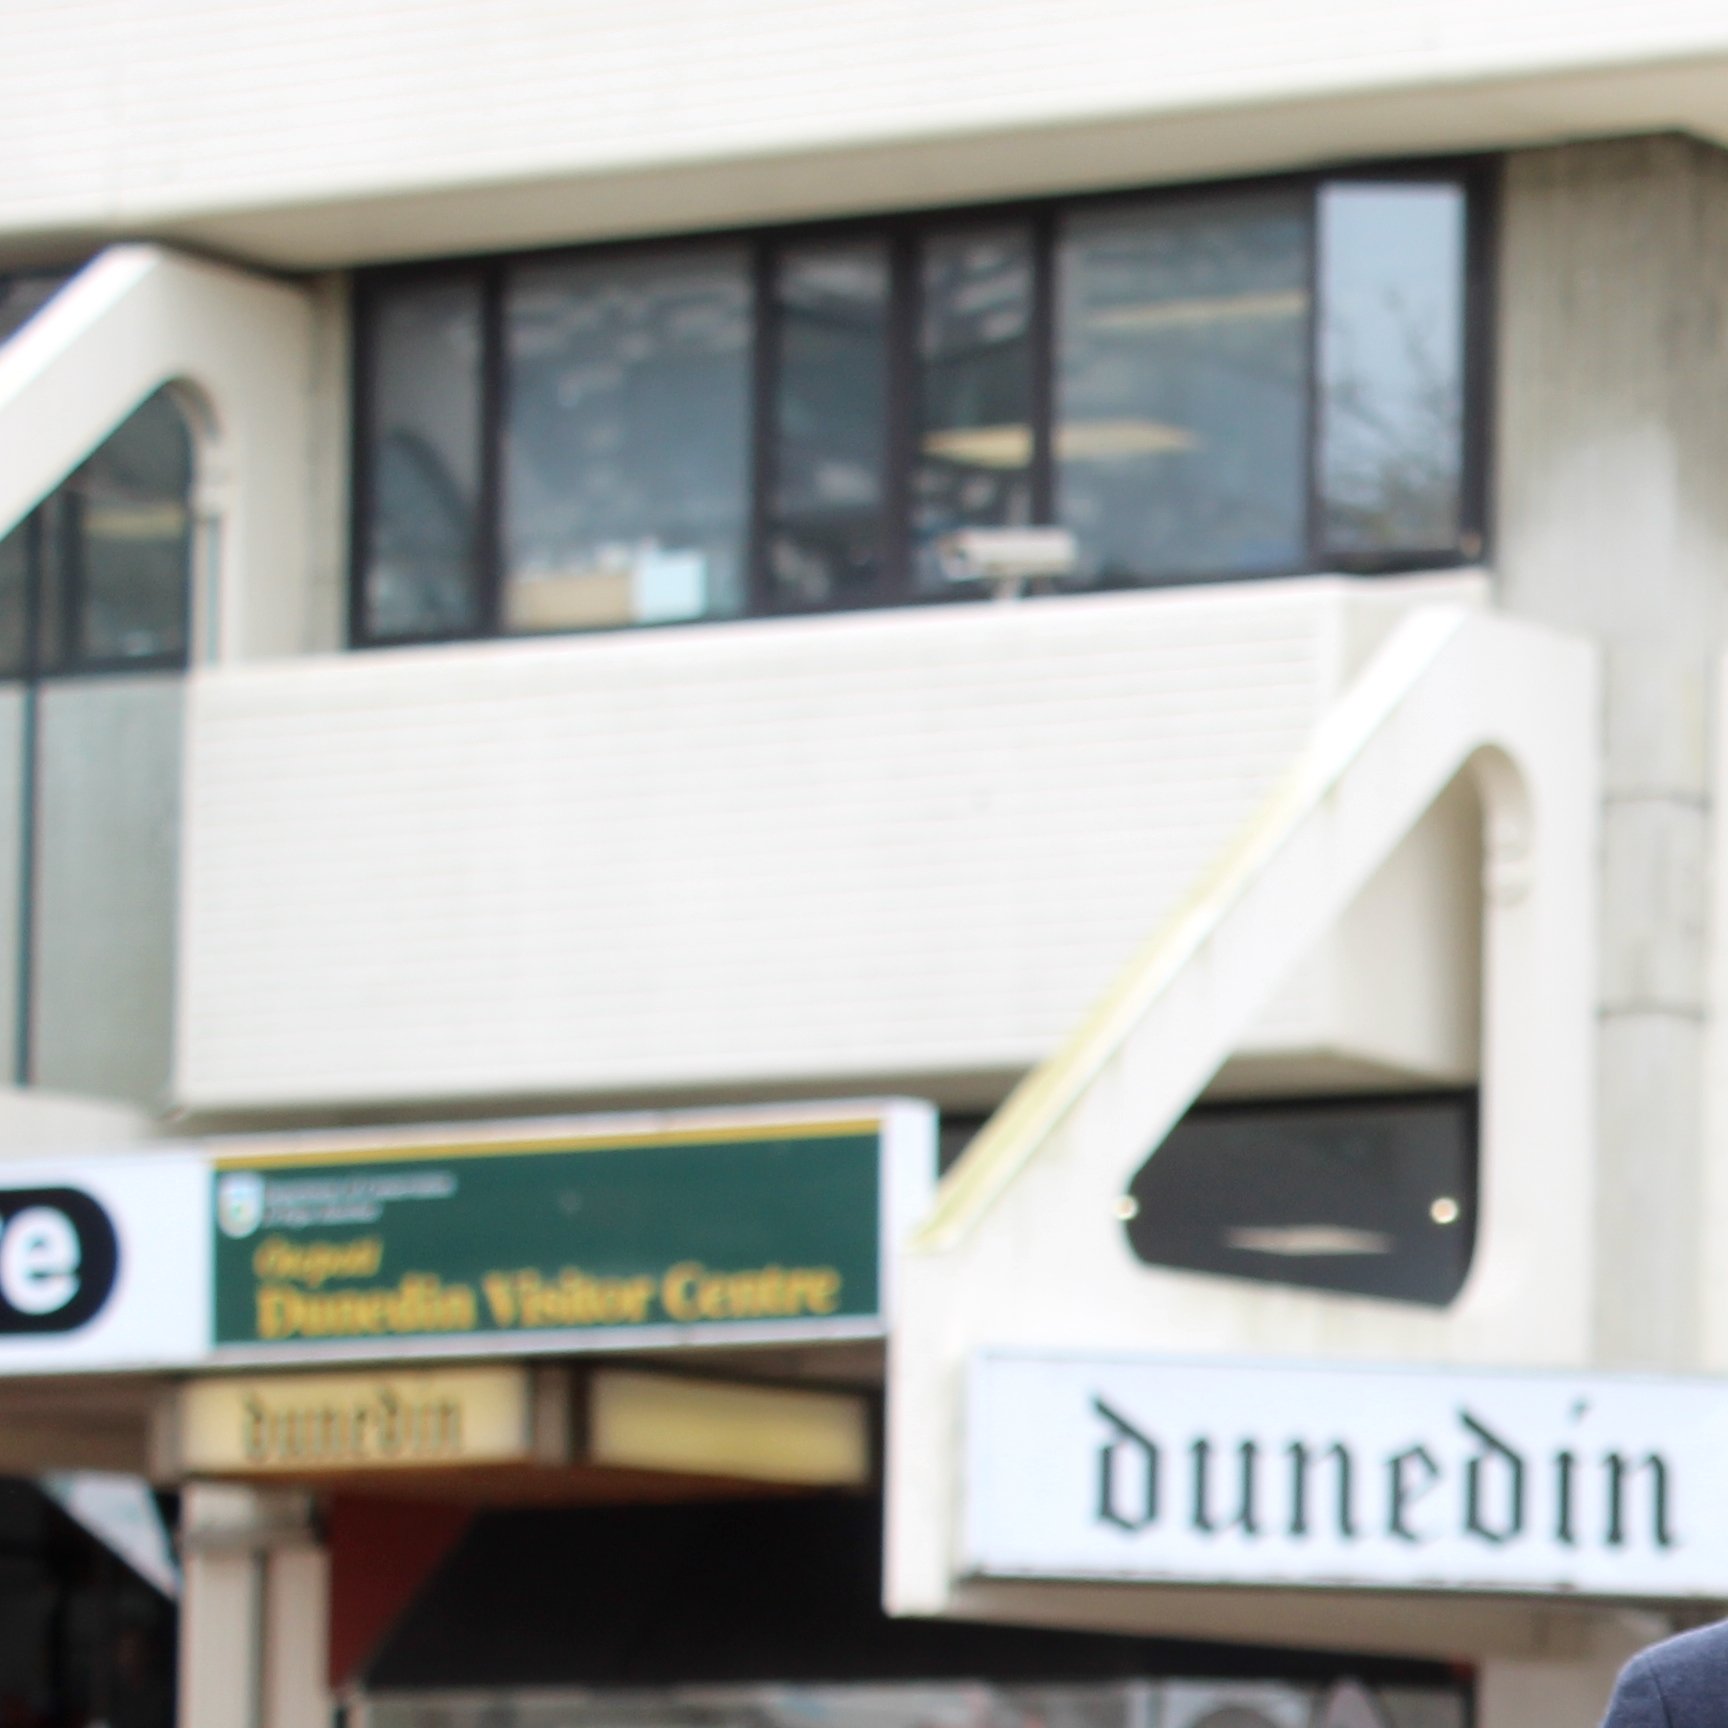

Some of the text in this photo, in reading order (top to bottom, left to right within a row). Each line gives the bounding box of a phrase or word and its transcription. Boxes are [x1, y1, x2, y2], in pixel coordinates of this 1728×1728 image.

[257, 1260, 840, 1340] Dunedin Visitor Centre
[1089, 1393, 1677, 1548] dunedin
